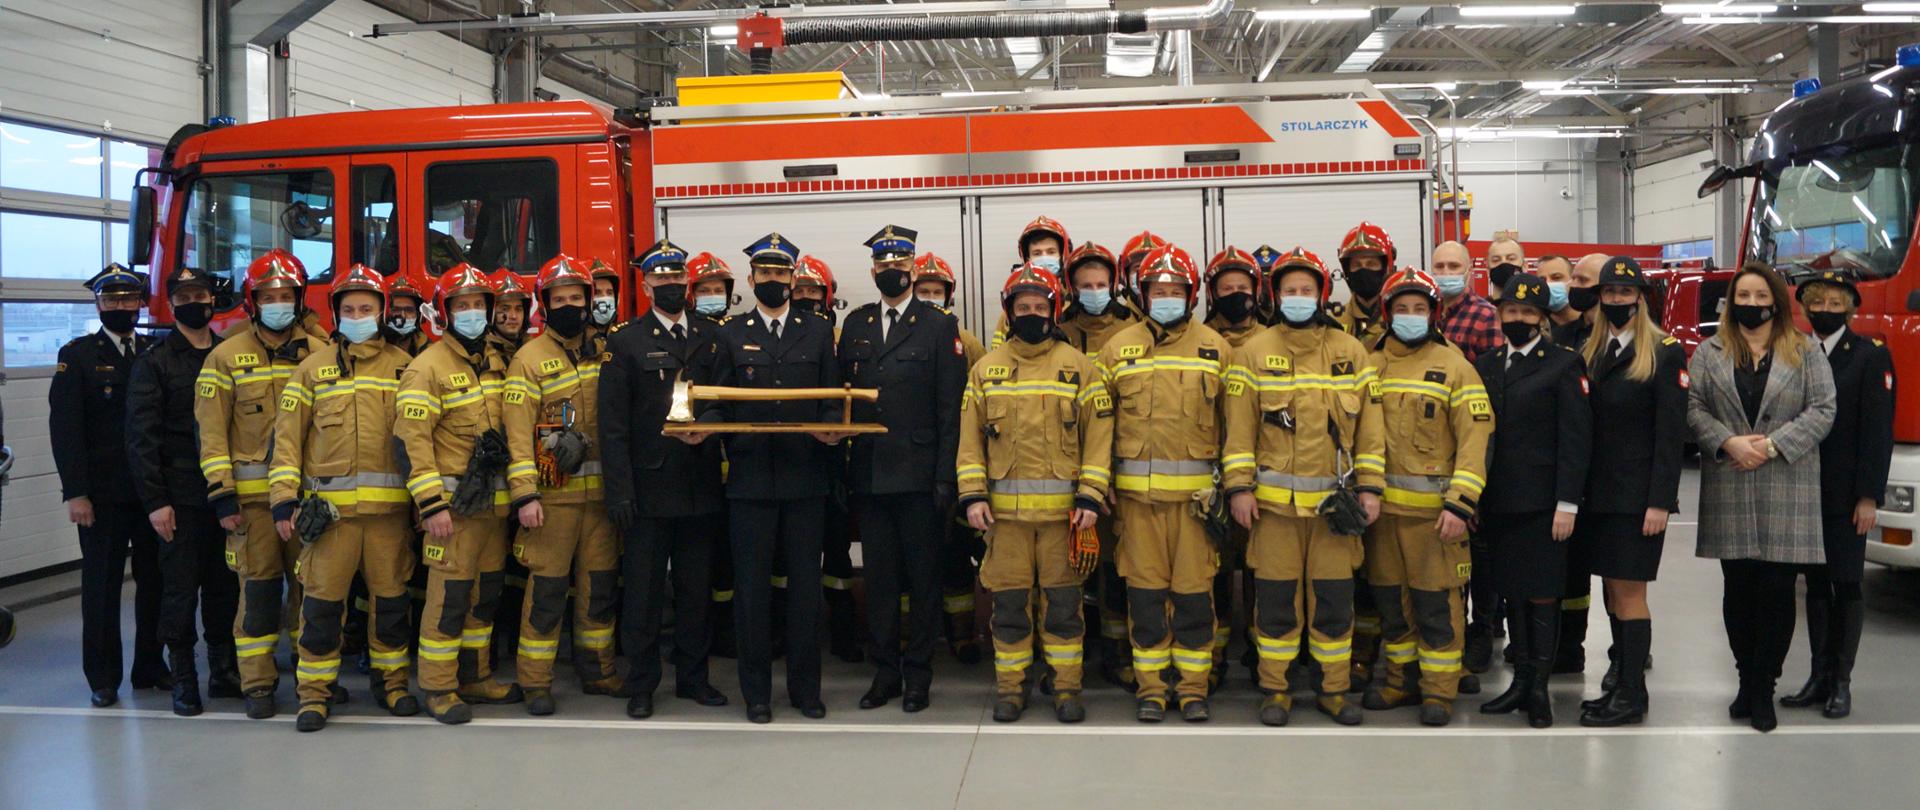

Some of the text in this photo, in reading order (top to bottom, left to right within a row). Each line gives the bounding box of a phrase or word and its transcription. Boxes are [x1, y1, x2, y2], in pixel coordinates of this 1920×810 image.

[1281, 120, 1368, 132] STOLARCZYK
[1123, 347, 1140, 355] PSP
[238, 355, 255, 363] PSP
[1269, 358, 1286, 366] PSP
[543, 360, 560, 370] PSP
[988, 367, 1005, 375] PSP
[407, 408, 425, 418] PSP
[427, 547, 441, 558] PSP
